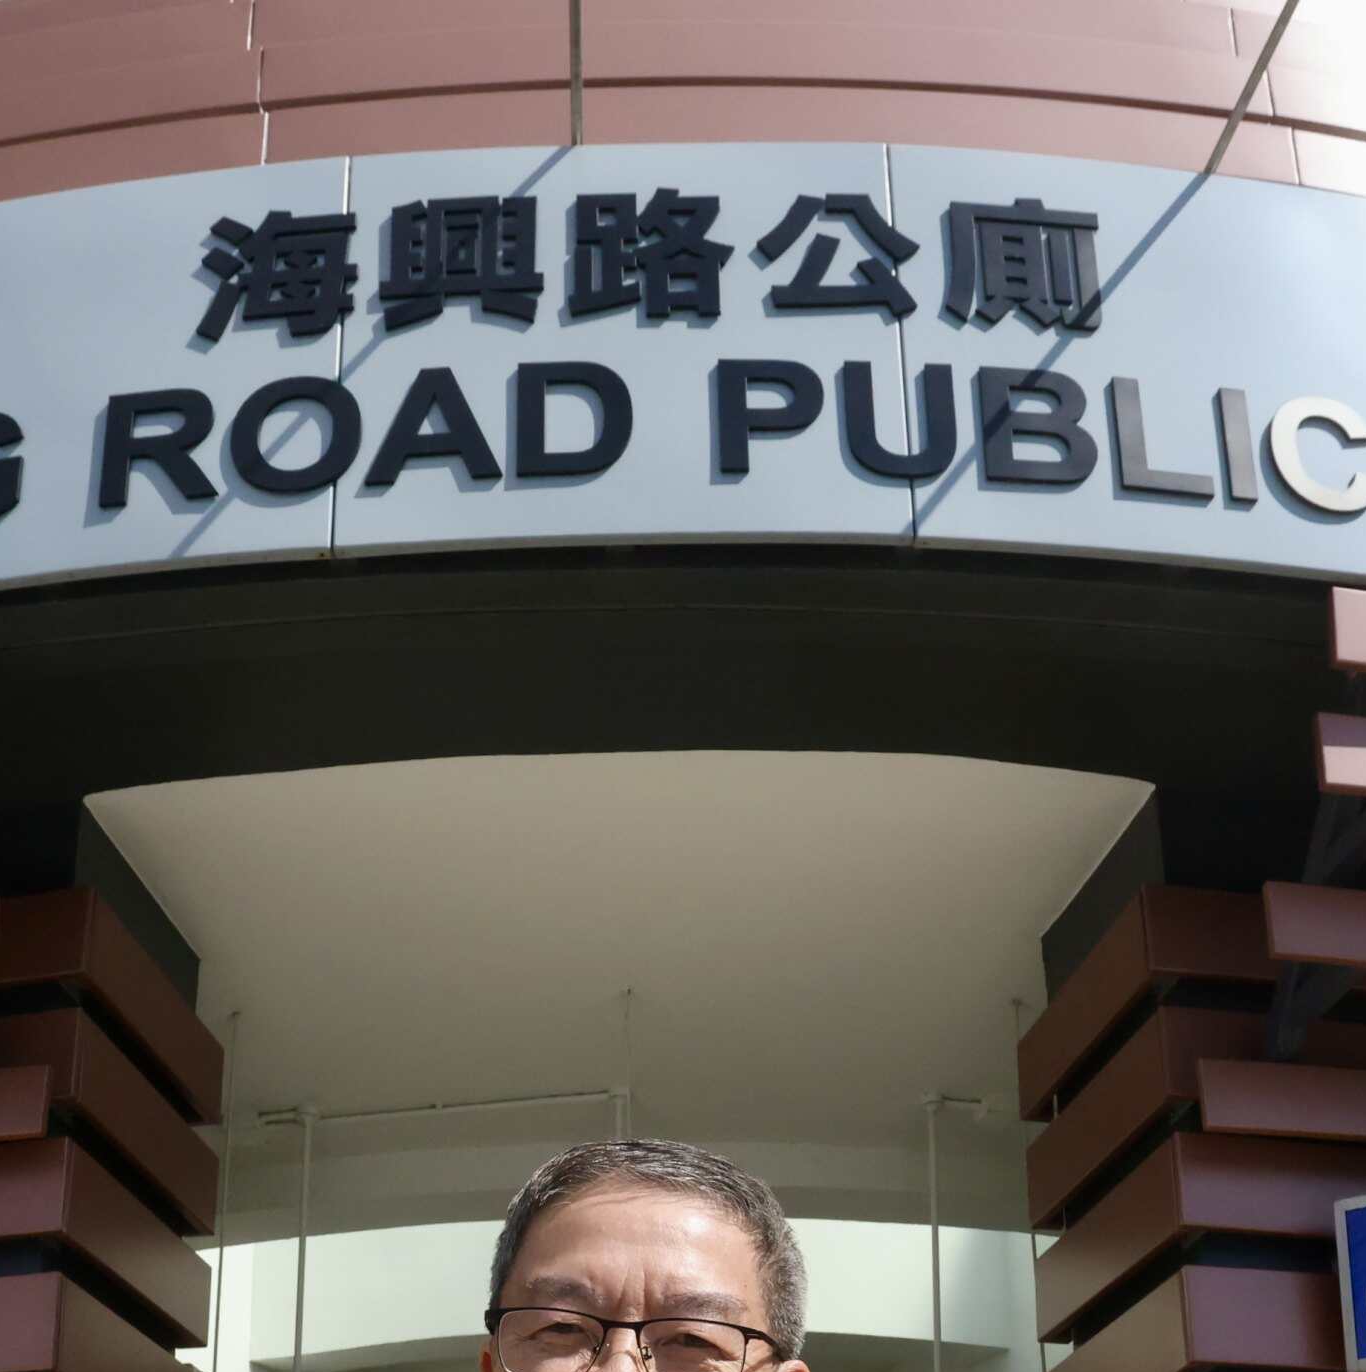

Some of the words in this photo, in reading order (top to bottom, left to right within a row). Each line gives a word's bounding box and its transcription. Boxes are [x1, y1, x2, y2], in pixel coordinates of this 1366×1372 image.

[195, 187, 1102, 341] 海興路公廁
[99, 361, 634, 510] ROAD
